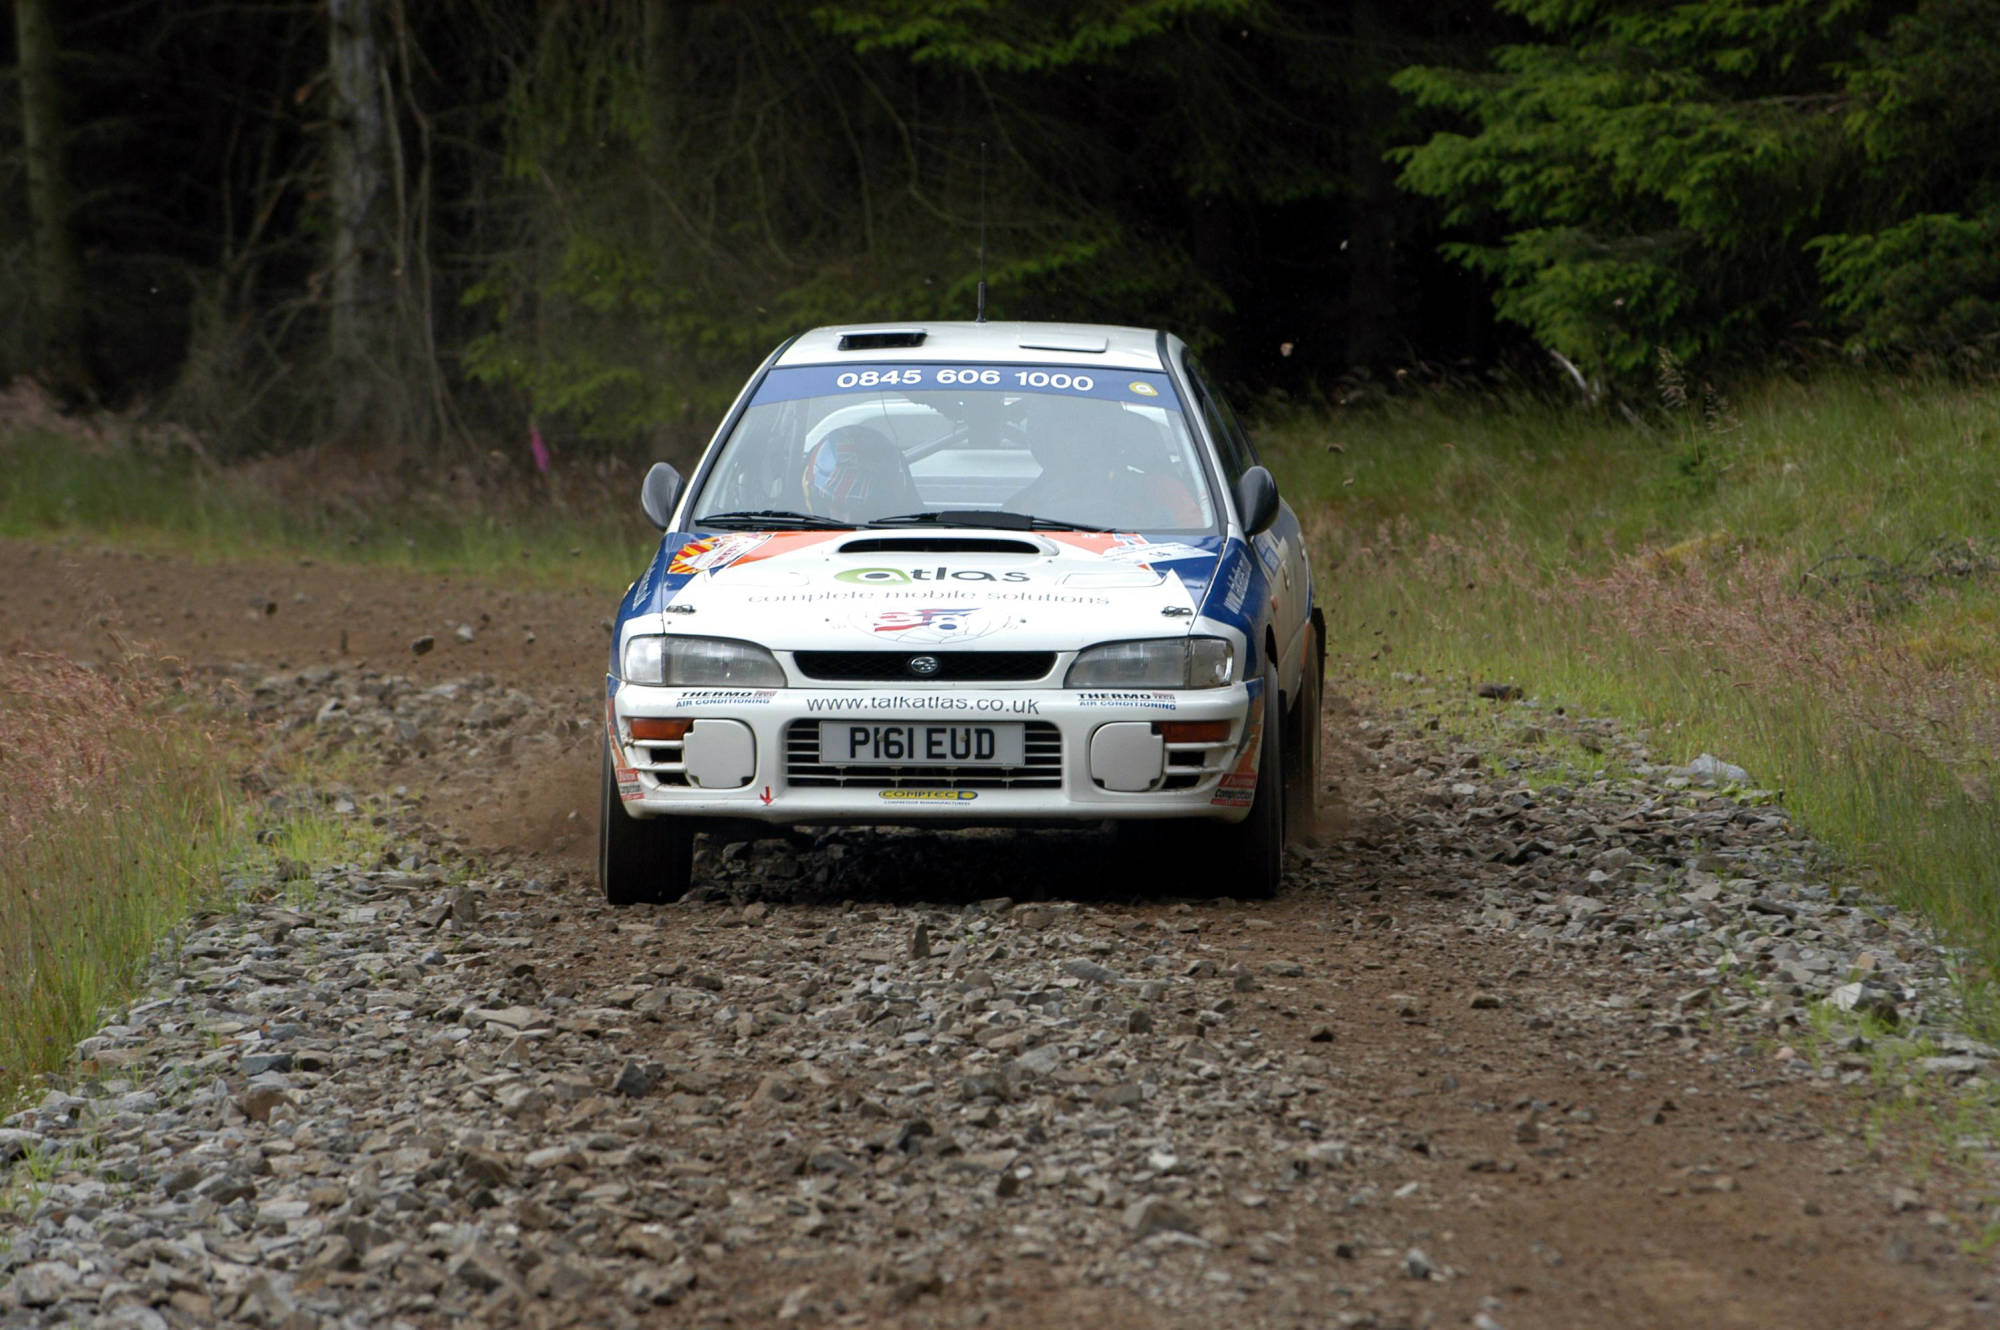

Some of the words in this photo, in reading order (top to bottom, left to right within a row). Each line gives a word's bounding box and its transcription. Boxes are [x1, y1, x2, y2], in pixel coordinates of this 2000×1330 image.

[837, 369, 922, 389] 0845
[936, 368, 1001, 384] 606
[1014, 371, 1095, 392] 1000
[748, 591, 875, 603] complete
[885, 589, 976, 600] mobile
[987, 591, 1110, 605] solutions
[675, 700, 693, 708] AIR
[695, 698, 771, 706] CONDITIONING
[1077, 692, 1150, 700] THERMO
[806, 696, 1040, 715] www.talkatlas.co.uk
[1099, 700, 1177, 711] CONDITIONING
[850, 727, 914, 760] P161
[926, 727, 995, 760] EUD
